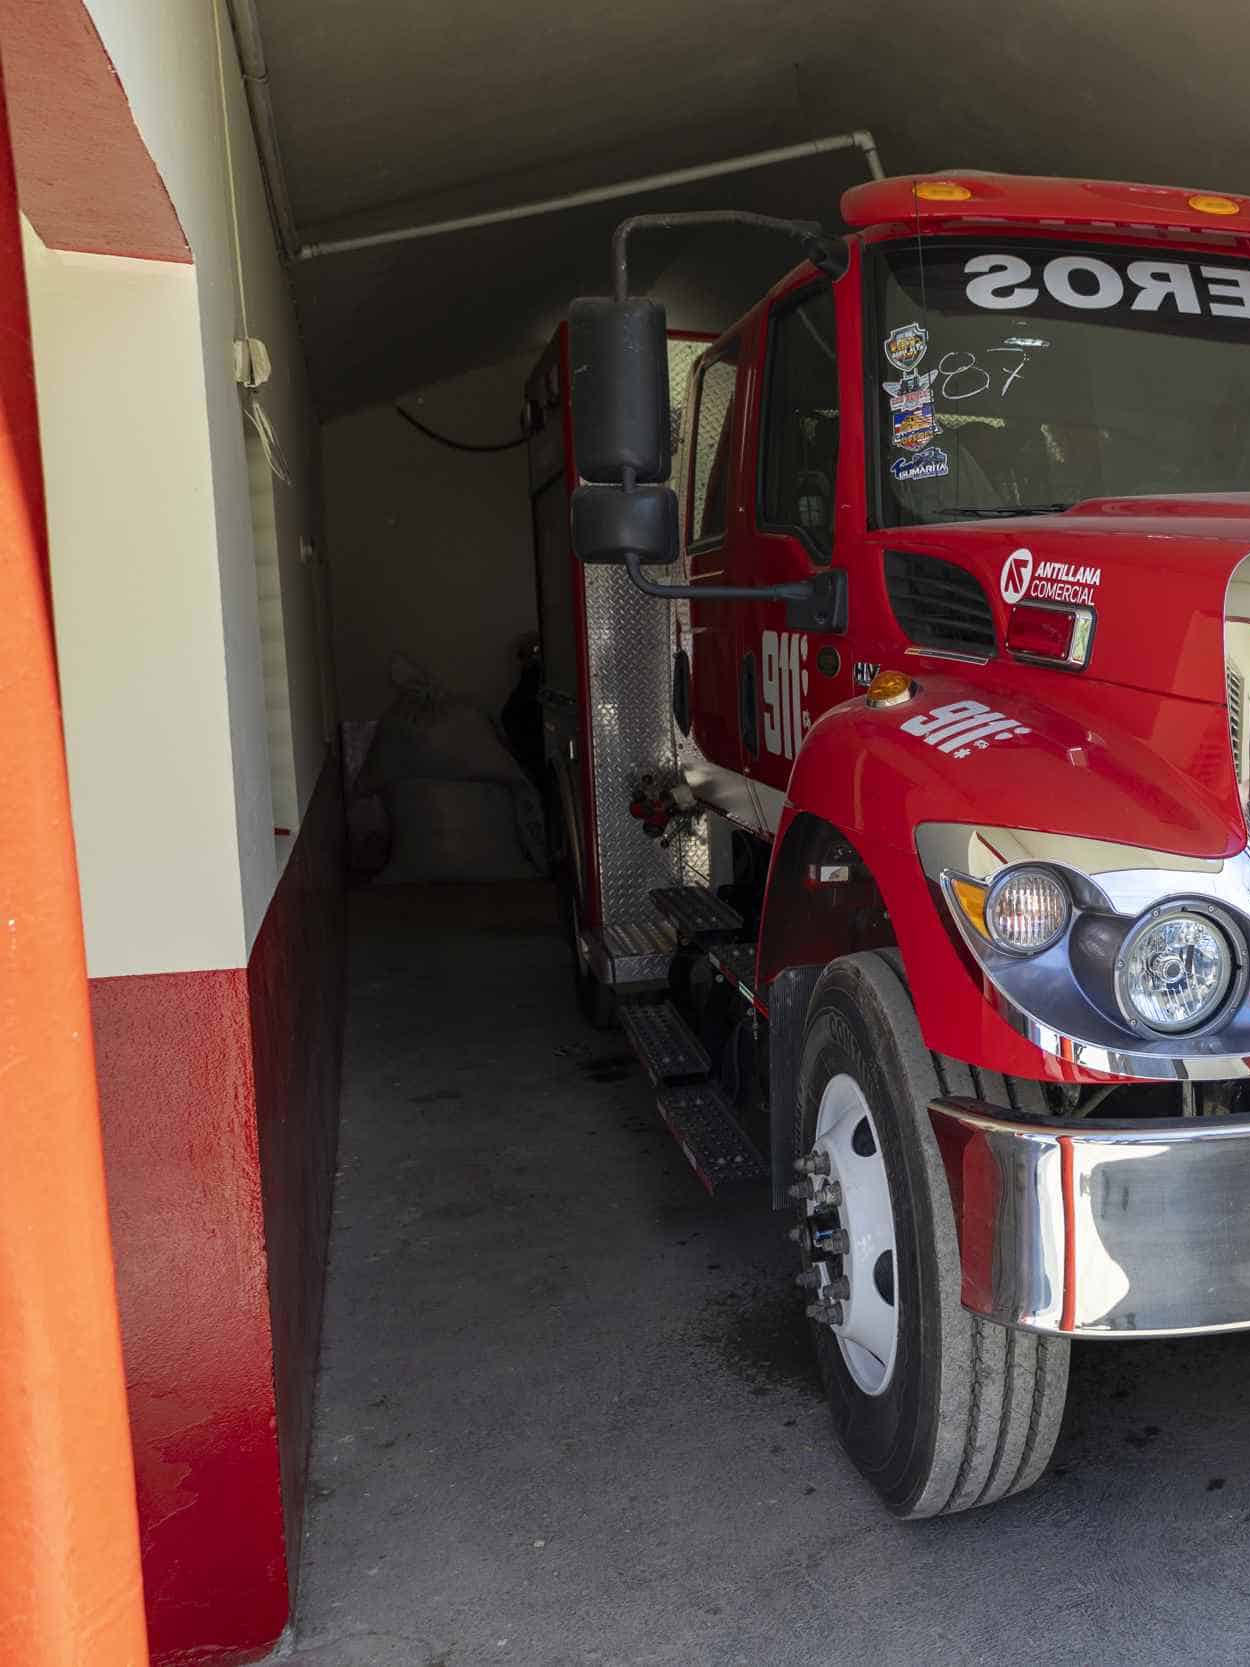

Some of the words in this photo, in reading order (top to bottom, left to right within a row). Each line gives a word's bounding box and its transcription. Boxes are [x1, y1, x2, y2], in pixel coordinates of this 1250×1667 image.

[1030, 580, 1095, 606] COMERCIAL
[1035, 561, 1101, 586] ANTILLANA
[762, 629, 803, 760] 911
[900, 699, 1023, 754] 911
